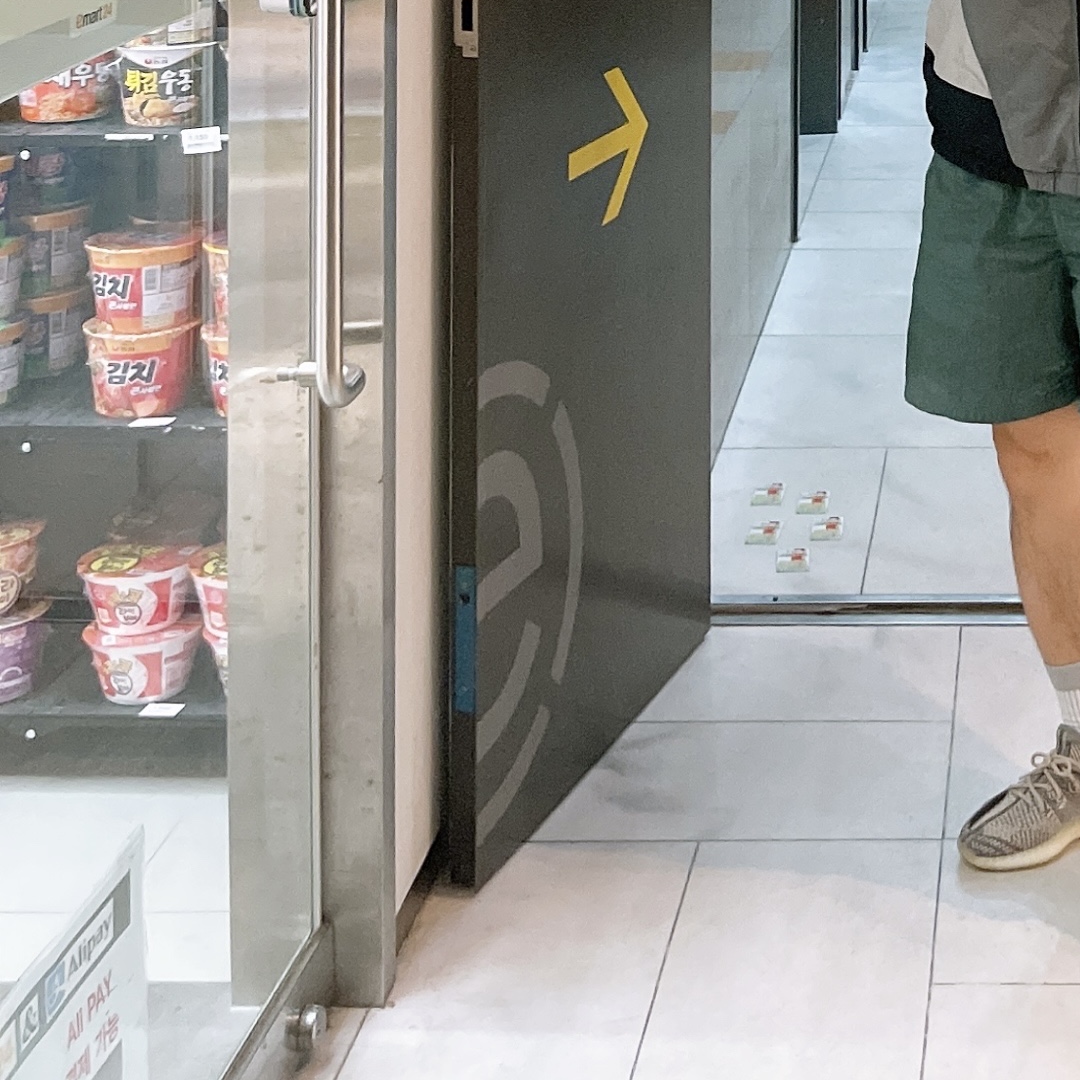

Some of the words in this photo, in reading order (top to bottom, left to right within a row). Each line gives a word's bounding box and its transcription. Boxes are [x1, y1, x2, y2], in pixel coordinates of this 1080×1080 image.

[93, 273, 131, 300] 김치
[106, 358, 157, 386] 김치
[66, 911, 113, 981] Alipay
[87, 968, 113, 1023] PAY
